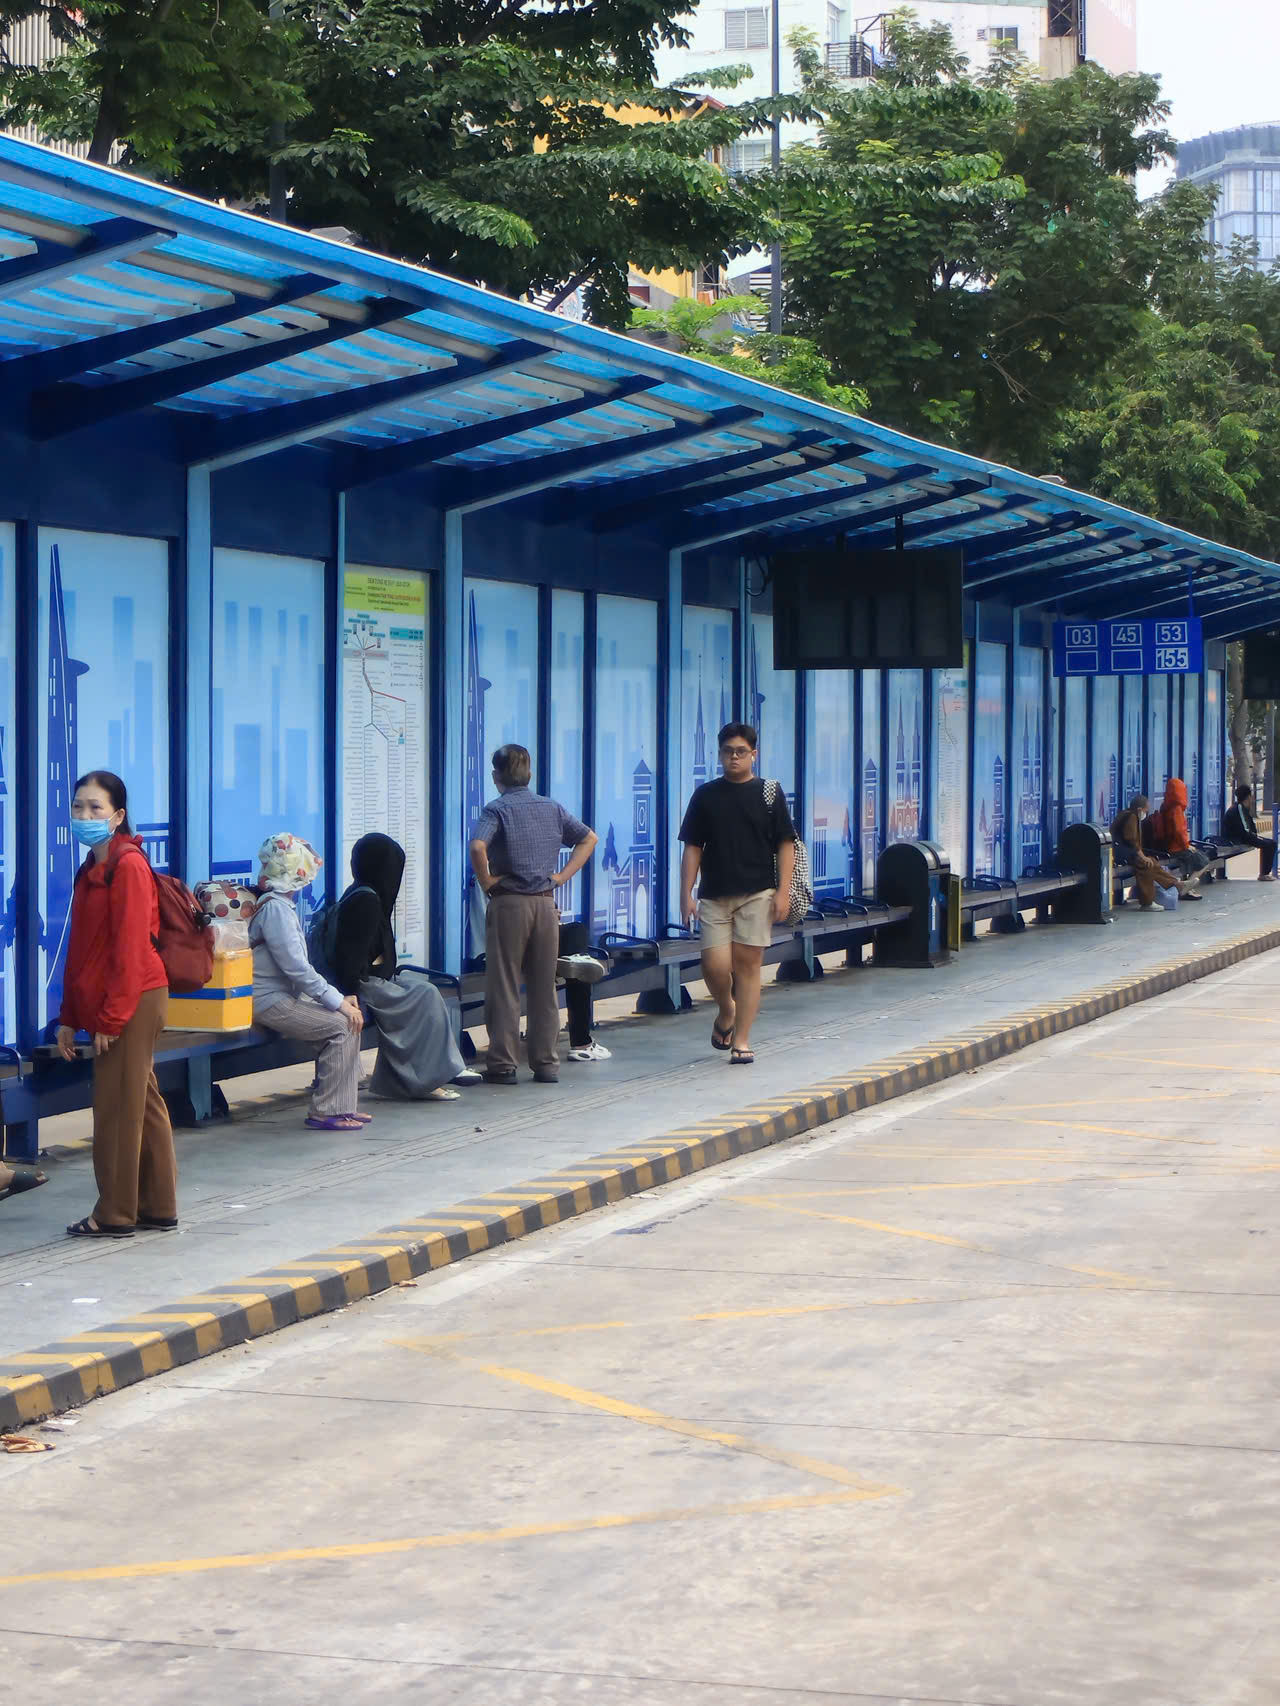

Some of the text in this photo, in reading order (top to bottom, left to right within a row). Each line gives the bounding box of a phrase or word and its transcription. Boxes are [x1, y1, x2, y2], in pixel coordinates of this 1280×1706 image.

[1072, 628, 1091, 645] 03
[1116, 627, 1137, 643] 45
[1161, 625, 1182, 642] 53
[1157, 649, 1187, 667] 155
